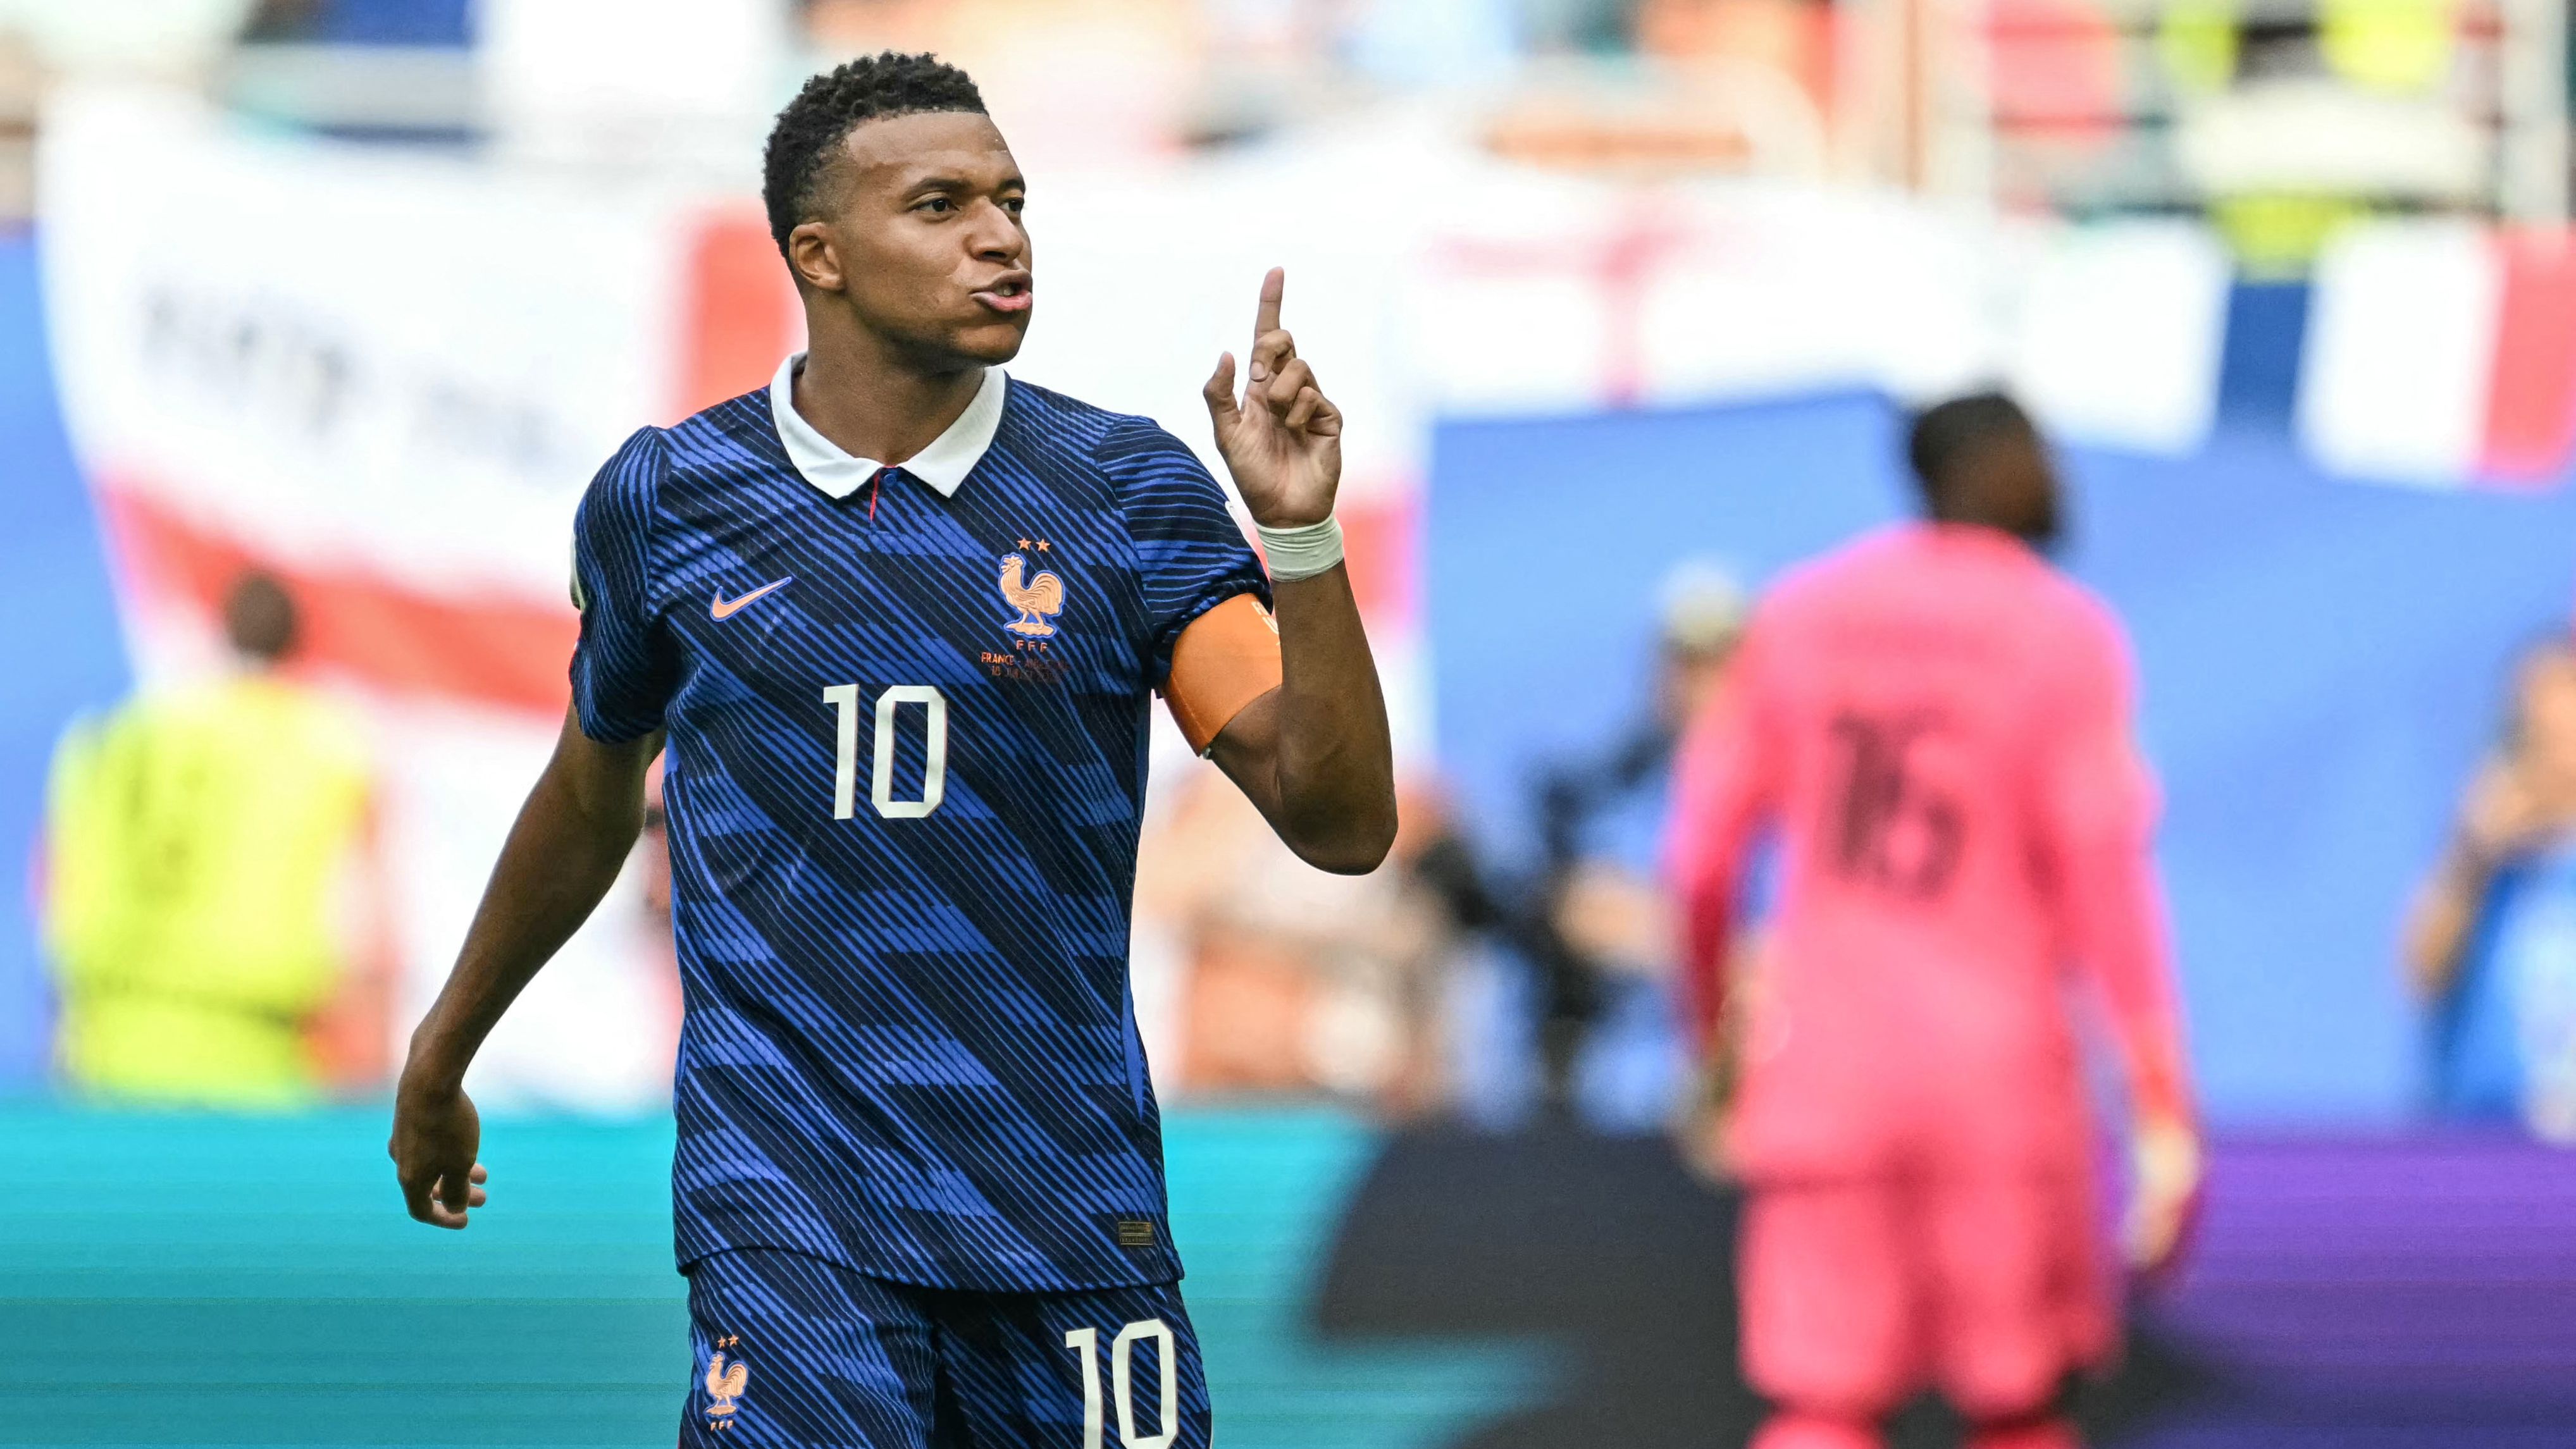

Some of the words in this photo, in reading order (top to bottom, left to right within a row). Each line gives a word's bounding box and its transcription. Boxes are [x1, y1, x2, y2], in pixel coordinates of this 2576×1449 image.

[981, 651, 1014, 665] FRANCE
[823, 684, 948, 820] 10
[1065, 1318, 1179, 1449] 10
